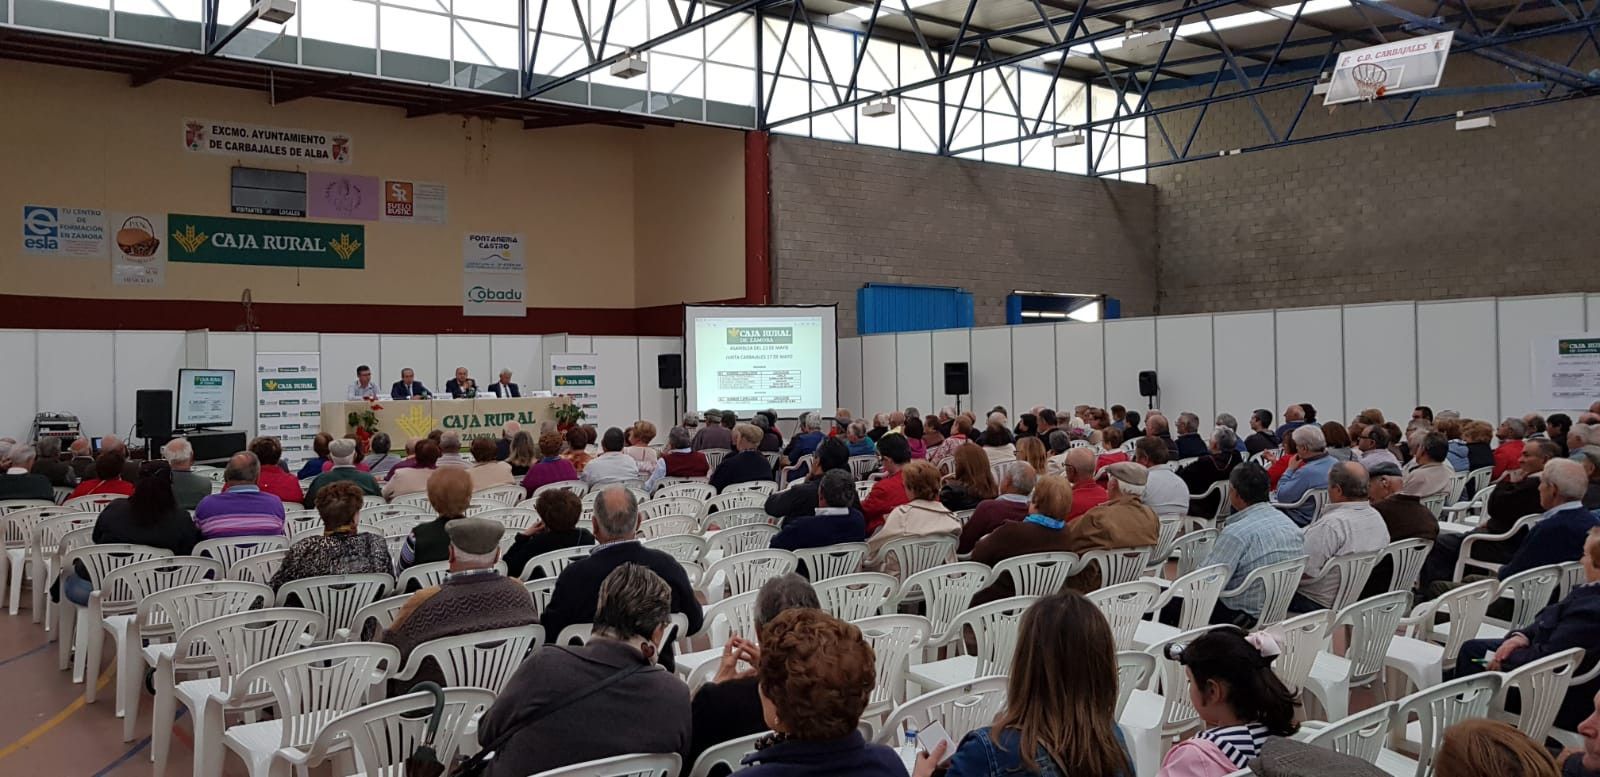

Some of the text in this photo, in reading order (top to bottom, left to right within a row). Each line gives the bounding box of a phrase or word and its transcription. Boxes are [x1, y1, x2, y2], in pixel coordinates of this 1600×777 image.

[1375, 43, 1428, 59] CARBAJALES
[212, 125, 326, 145] EXCMO. AYUNTAMIENTO
[209, 139, 329, 159] DE CARBAJALES DE ALBA
[25, 235, 58, 249] esla
[211, 232, 326, 252] CAJA RURAL
[739, 329, 792, 337] CAJA RURAL
[443, 411, 536, 430] CAJA RURAL
